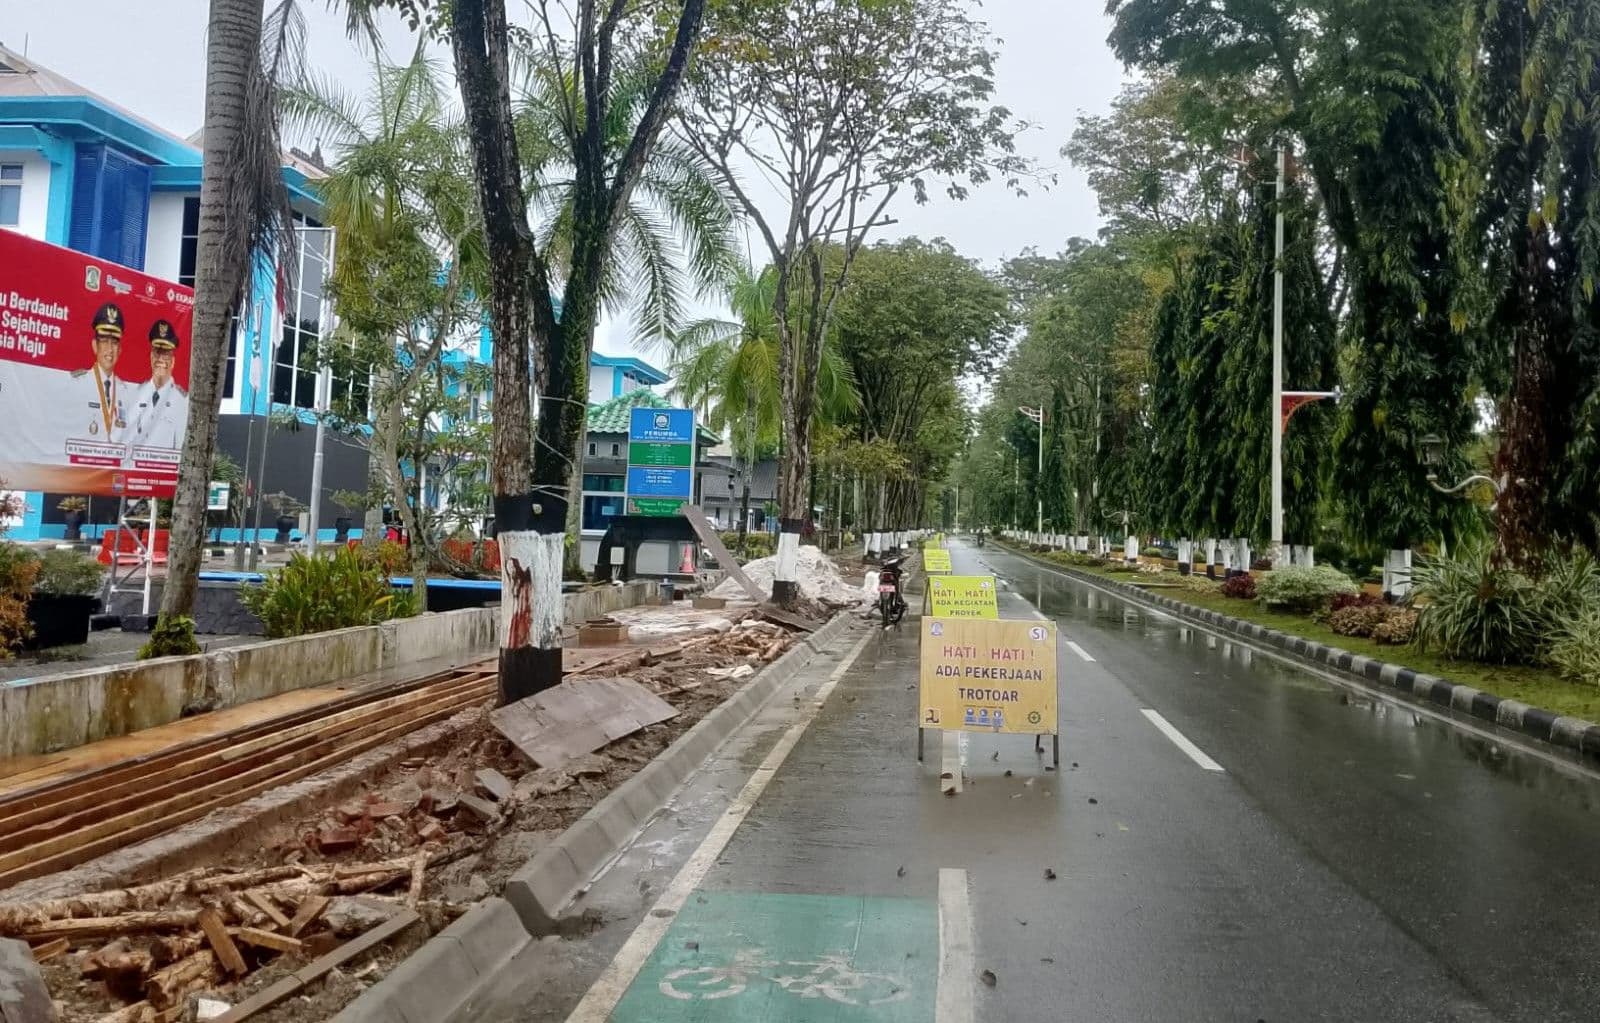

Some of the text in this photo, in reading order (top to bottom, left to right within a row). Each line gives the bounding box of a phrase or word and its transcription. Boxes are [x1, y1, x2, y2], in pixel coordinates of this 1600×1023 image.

[9, 291, 69, 321] Berdaulat
[1, 310, 61, 339] Sejahtera
[17, 334, 46, 358] Maju
[933, 589, 956, 599] HATI
[965, 590, 988, 599] HATI
[1032, 628, 1045, 640] SI
[943, 645, 976, 659] HATI
[991, 648, 1025, 661] HATI
[935, 665, 1042, 680] ADA PEKERJAAN
[959, 688, 1018, 702] TROTOAR
